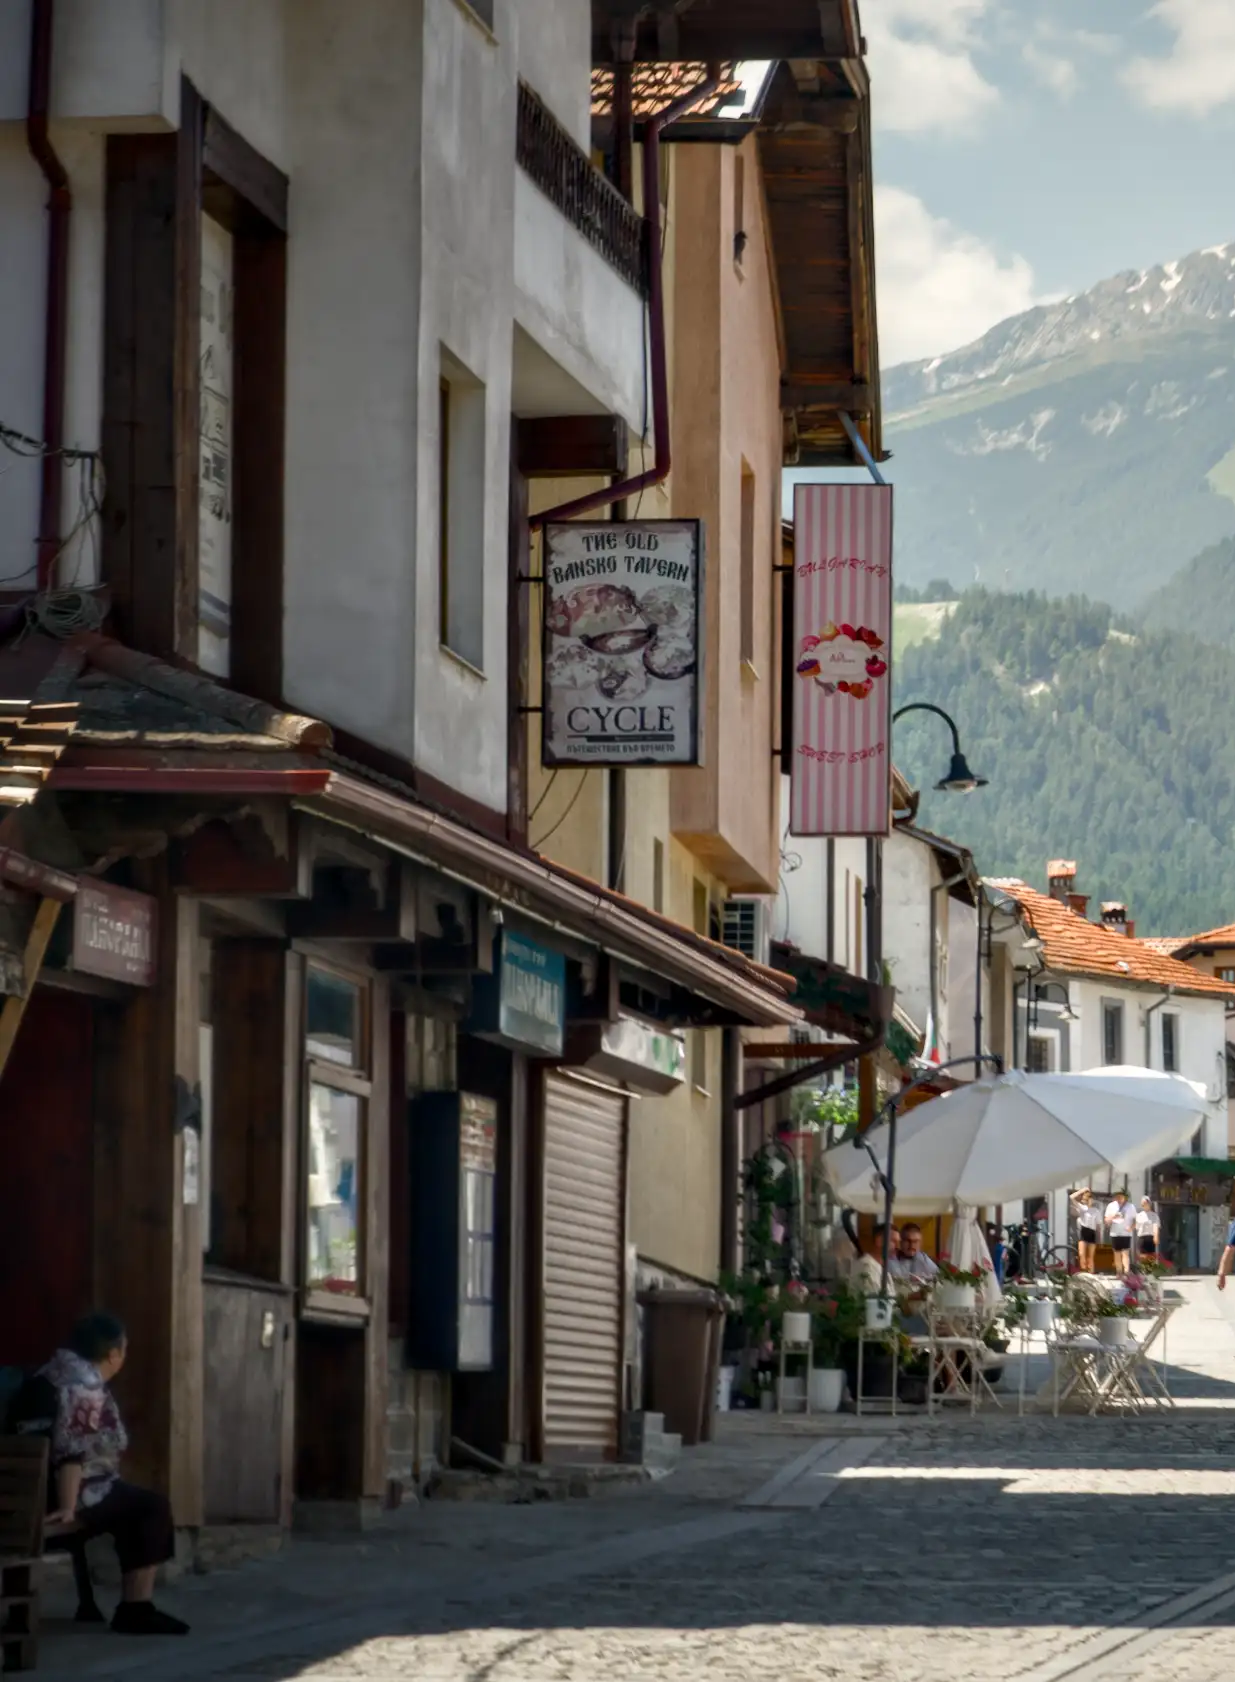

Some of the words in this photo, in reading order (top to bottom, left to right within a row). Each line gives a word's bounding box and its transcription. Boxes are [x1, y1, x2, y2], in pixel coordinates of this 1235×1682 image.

[582, 532, 618, 552] THE
[625, 532, 659, 552] OLD
[553, 556, 618, 585] BANSKO
[624, 555, 690, 582] TAVERN
[566, 705, 676, 733] CYCLE
